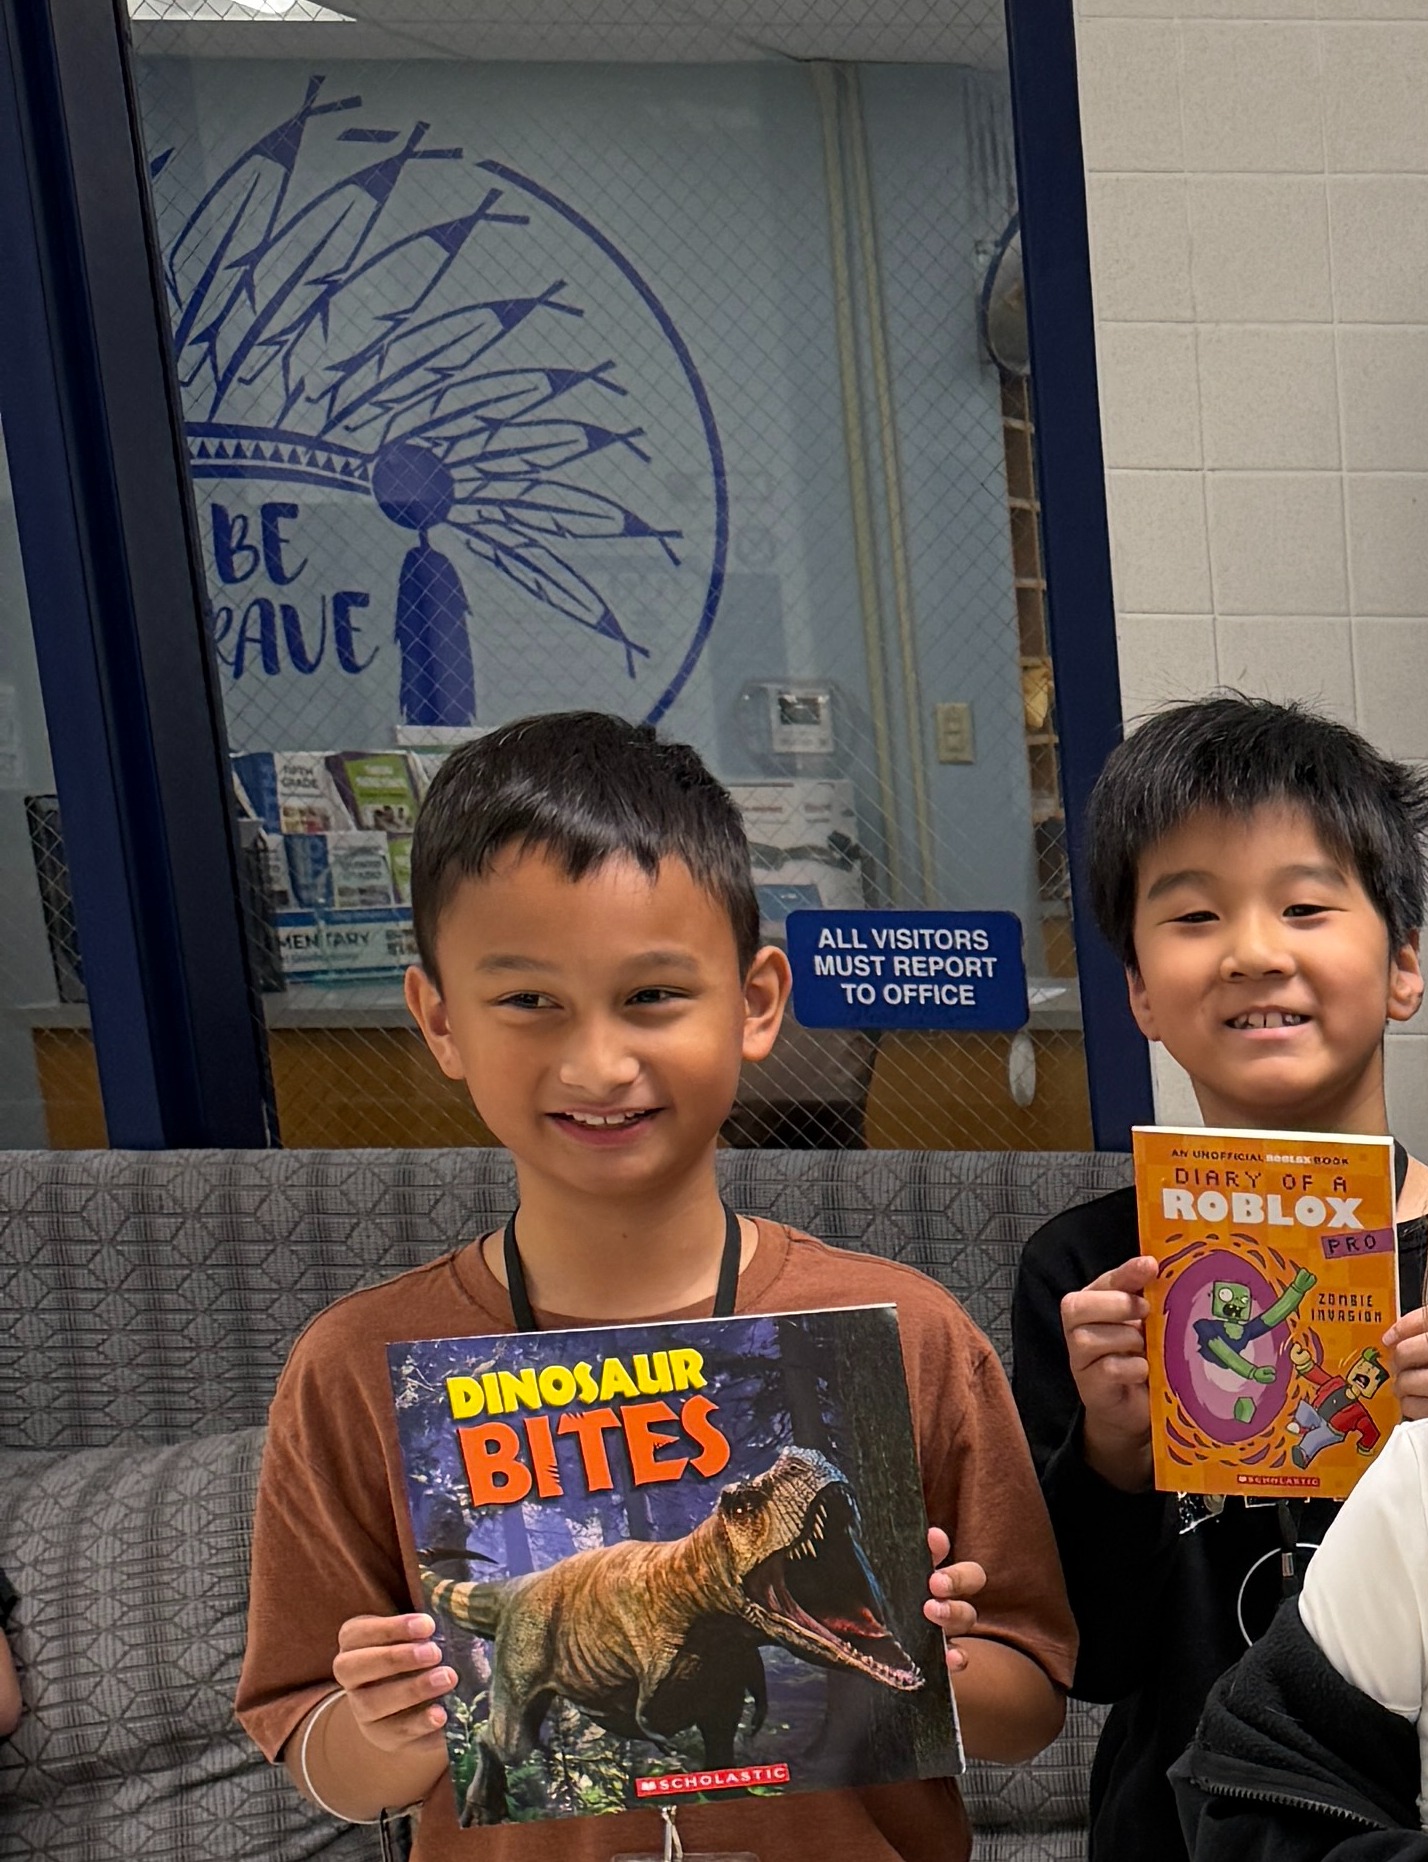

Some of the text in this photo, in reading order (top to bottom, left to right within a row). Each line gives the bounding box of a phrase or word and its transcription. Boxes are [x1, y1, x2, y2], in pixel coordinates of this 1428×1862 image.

[211, 502, 308, 585] BE
[214, 591, 379, 680] RAVE
[818, 928, 989, 950] ALL VISITORS
[814, 955, 997, 978] MUST REPORT
[841, 983, 976, 1005] TO OFFICE
[1171, 1149, 1188, 1158] AN
[1192, 1150, 1263, 1163] UNOFFICIAL
[1313, 1155, 1350, 1165] BOOK
[1175, 1167, 1348, 1193] DIARY OF A
[1161, 1188, 1364, 1230] ROBLOX
[1327, 1234, 1377, 1255] PRO
[1318, 1293, 1374, 1308] ZOMBIE
[1311, 1308, 1383, 1323] INVASION
[446, 1347, 708, 1421] DINOSAUR
[458, 1395, 731, 1508] BITES
[659, 1767, 786, 1791] SCHOLASTIC
